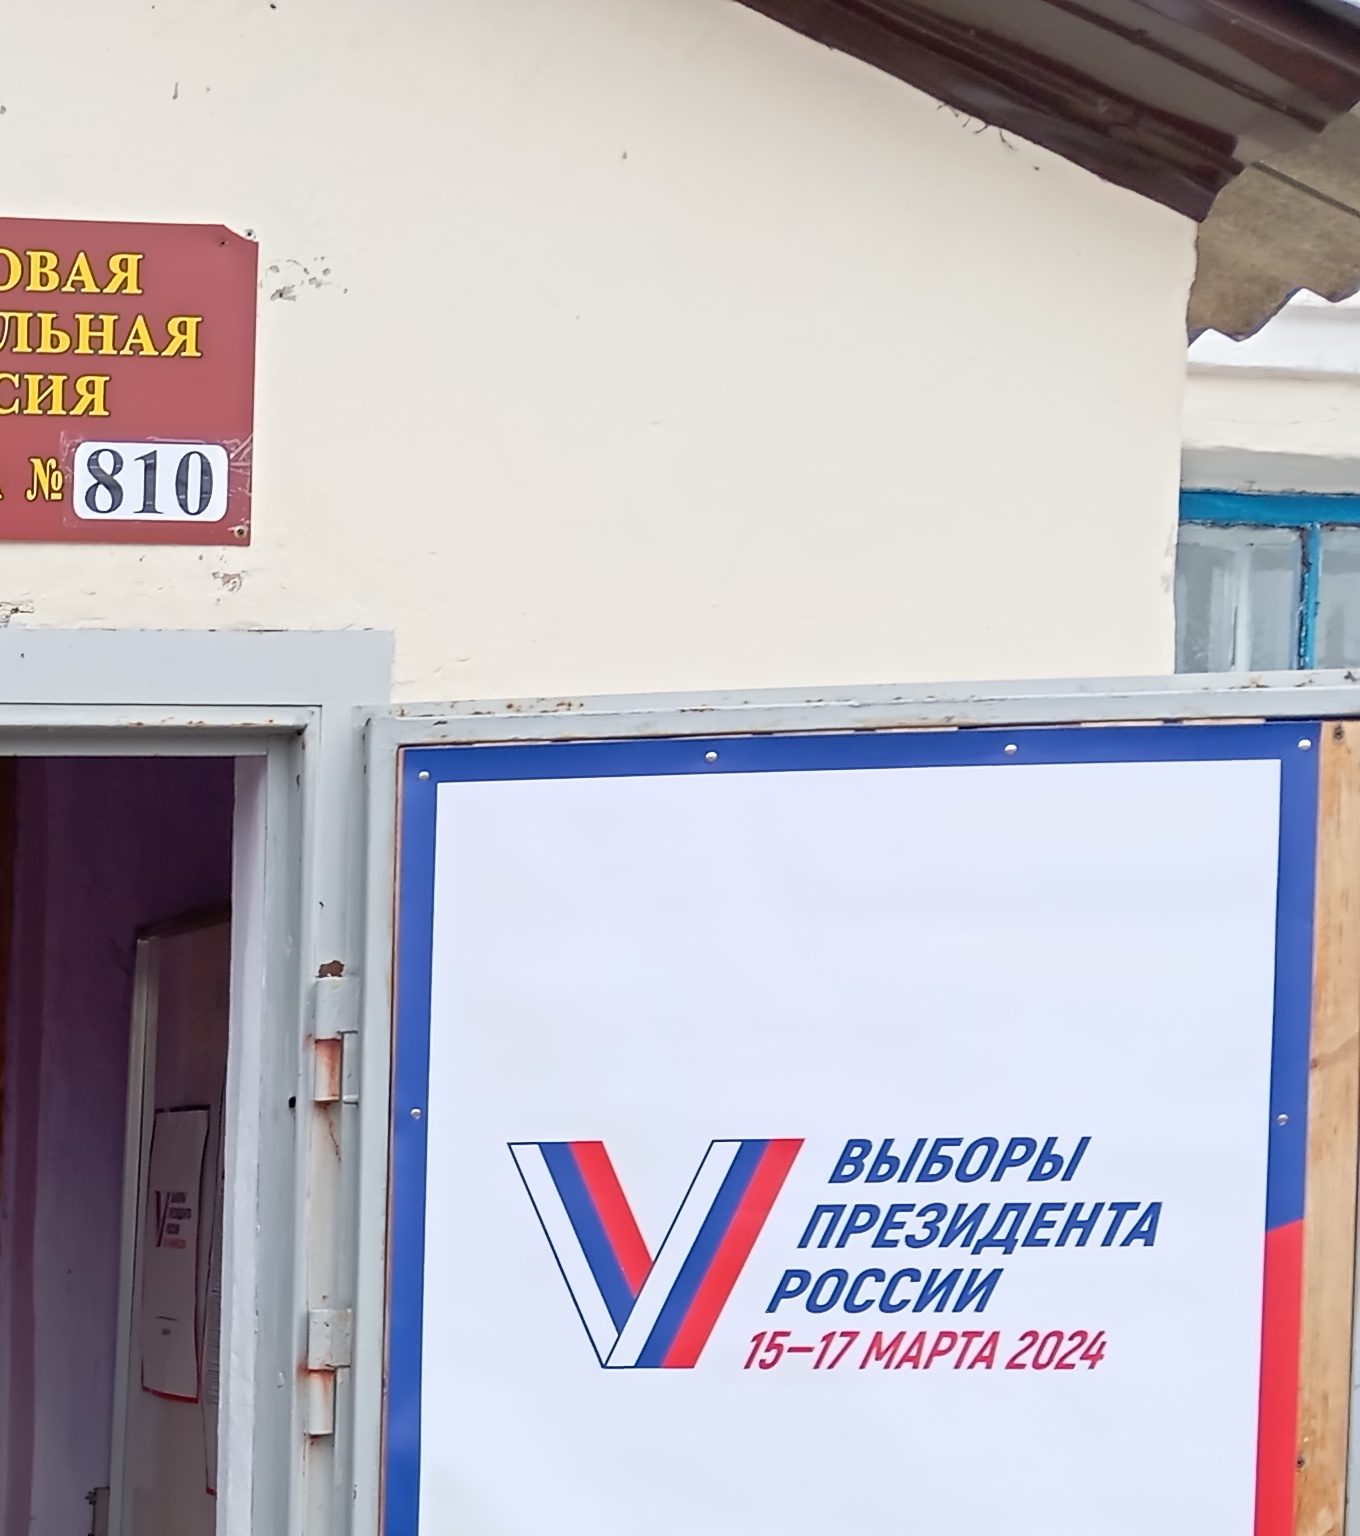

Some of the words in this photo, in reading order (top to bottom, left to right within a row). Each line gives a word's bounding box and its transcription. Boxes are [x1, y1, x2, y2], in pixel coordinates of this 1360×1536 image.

[26, 458, 63, 502] №
[83, 449, 211, 515] 810
[828, 1136, 1092, 1184] ВЫБОРЫ
[796, 1202, 1164, 1255] ПРЕЗИДЕНТА
[765, 1268, 1004, 1314] РОССИИ
[860, 1331, 997, 1370] МАРТА
[1004, 1330, 1108, 1370] 2024
